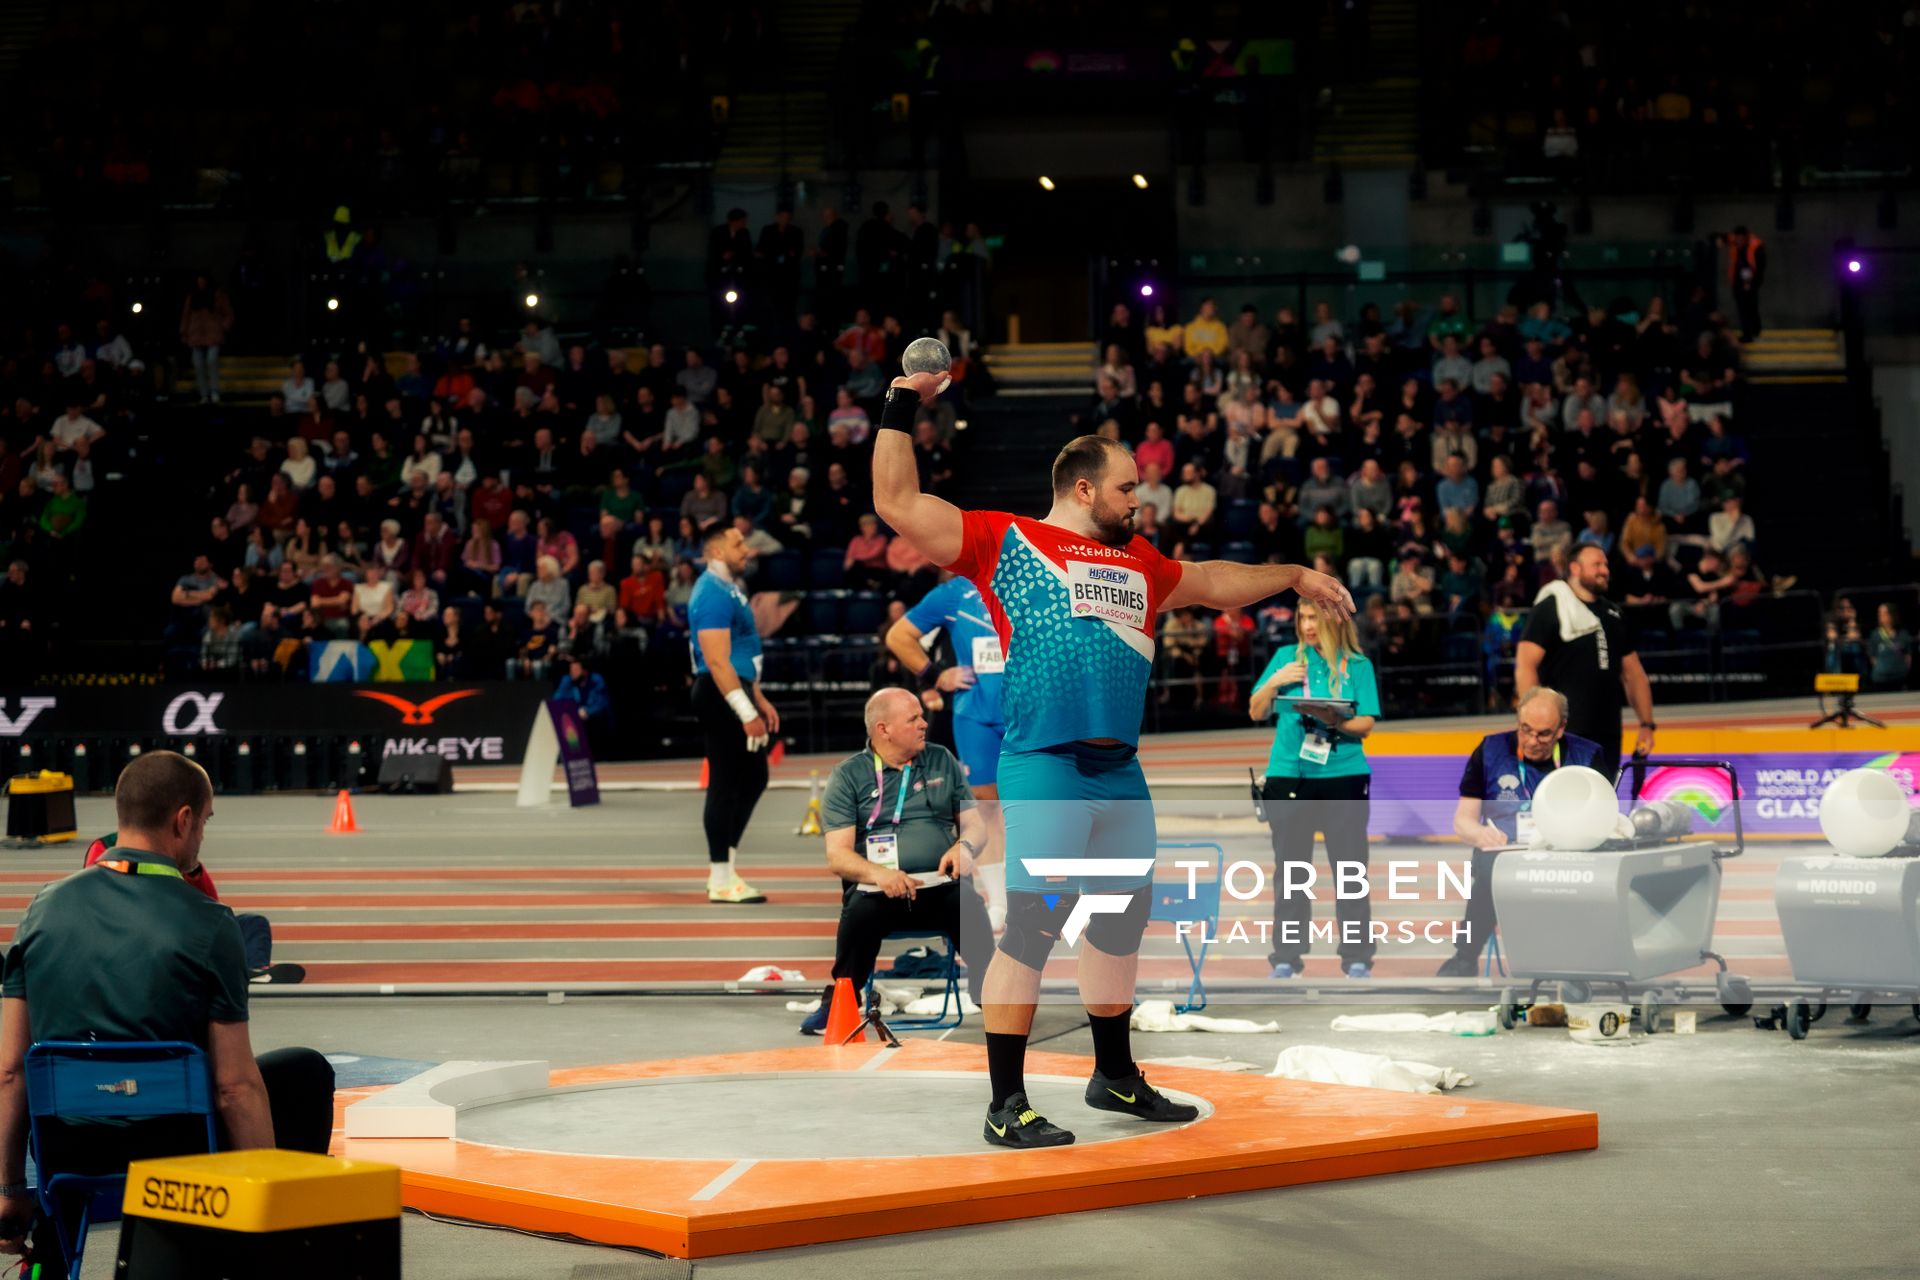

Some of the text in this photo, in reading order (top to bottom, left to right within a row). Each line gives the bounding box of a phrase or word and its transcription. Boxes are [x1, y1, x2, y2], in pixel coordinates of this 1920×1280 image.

[1057, 545, 1141, 561] LUXEMBOU
[1088, 567, 1129, 584] HI-CHEW
[1074, 583, 1144, 611] BERTEMES
[1133, 615, 1142, 624] 24
[1756, 769, 1819, 785] WORLD
[1756, 798, 1820, 819] GLAS
[1528, 869, 1594, 883] MONDO
[1810, 879, 1877, 895] MONDO
[143, 1177, 230, 1218] SEIKO
